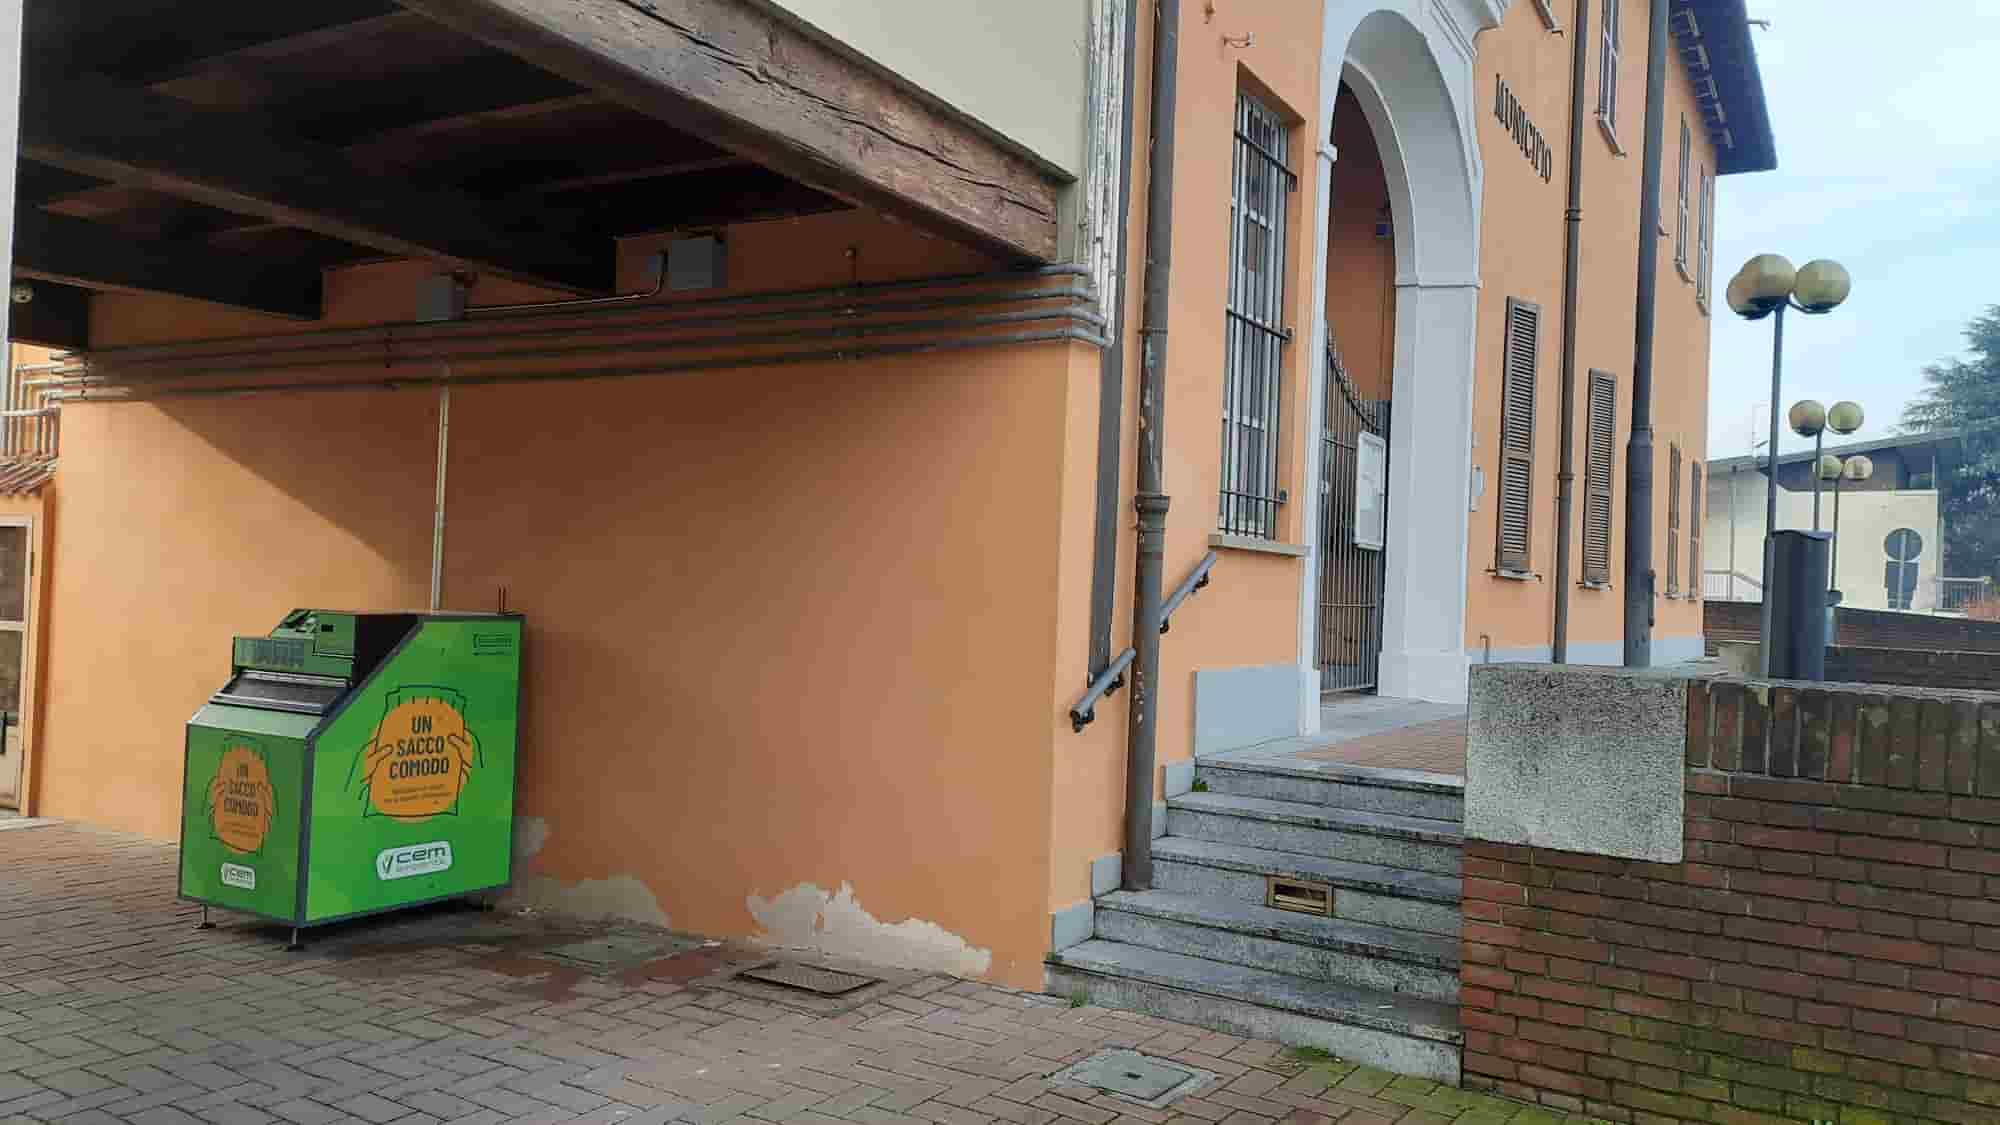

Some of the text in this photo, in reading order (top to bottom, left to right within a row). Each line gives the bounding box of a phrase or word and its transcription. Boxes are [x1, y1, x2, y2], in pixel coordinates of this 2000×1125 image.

[412, 714, 432, 734] UN
[397, 735, 445, 757] SACCO
[389, 757, 450, 780] COMODO
